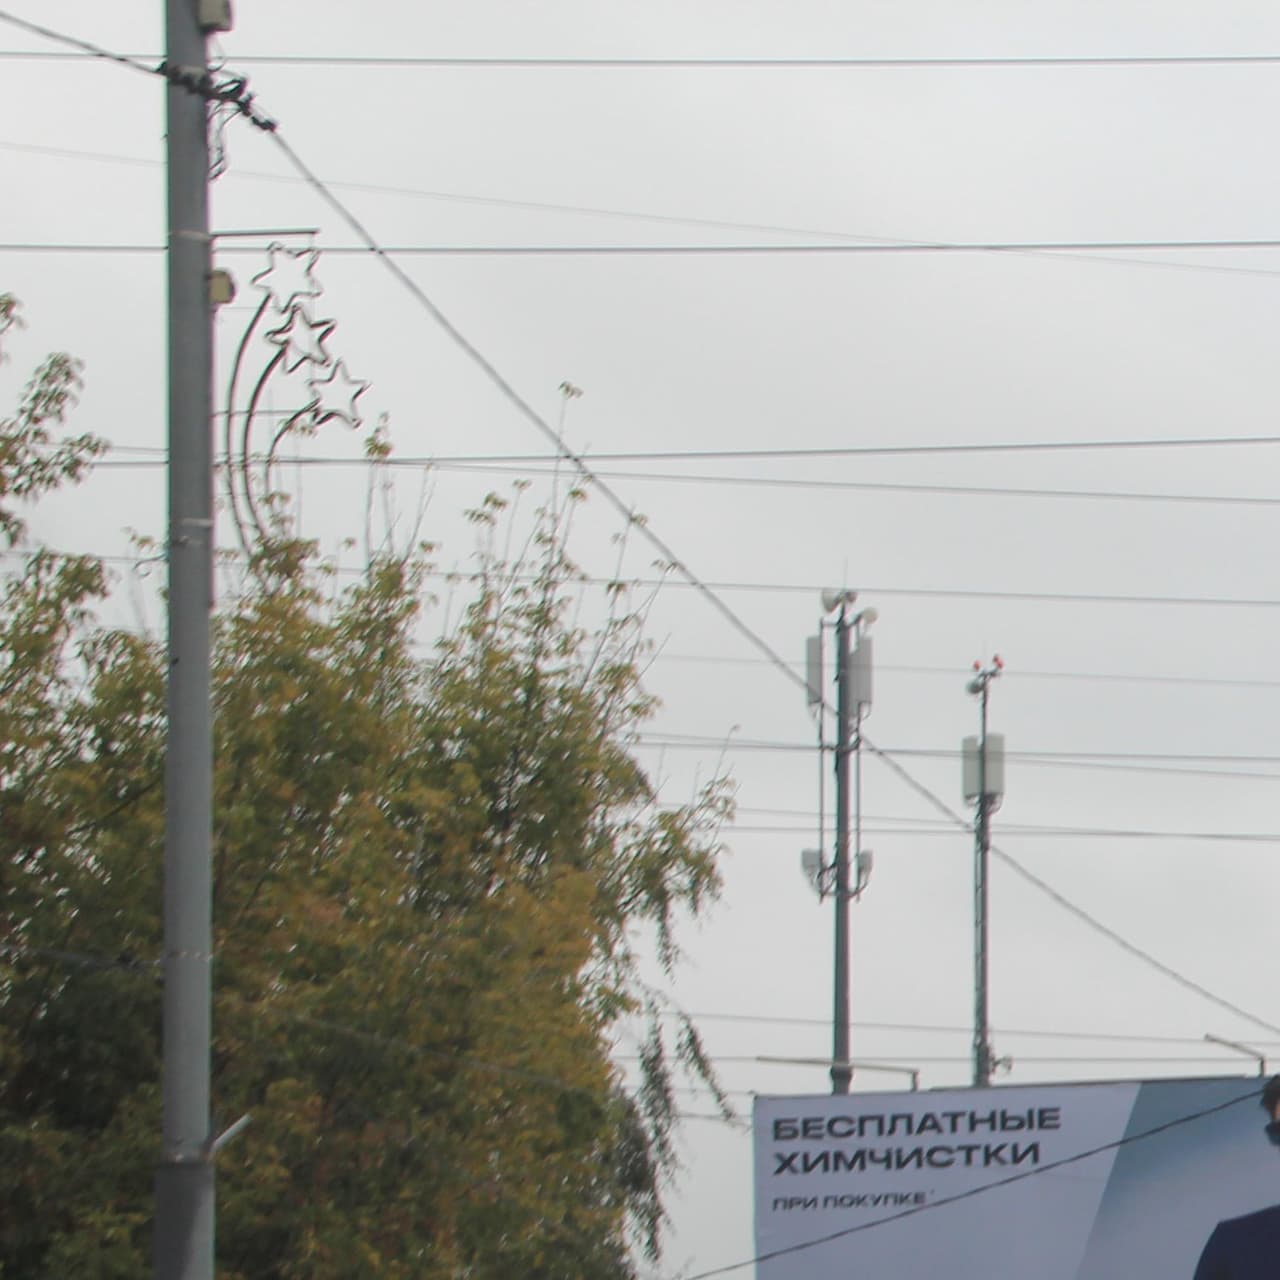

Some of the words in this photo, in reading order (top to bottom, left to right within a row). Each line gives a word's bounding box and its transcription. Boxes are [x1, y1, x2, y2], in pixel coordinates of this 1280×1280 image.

[773, 1106, 1062, 1142] БЕСПЛАТНЫЕ
[773, 1142, 1041, 1176] ХИМЧИСТКИ
[772, 1196, 818, 1212] ПРИ
